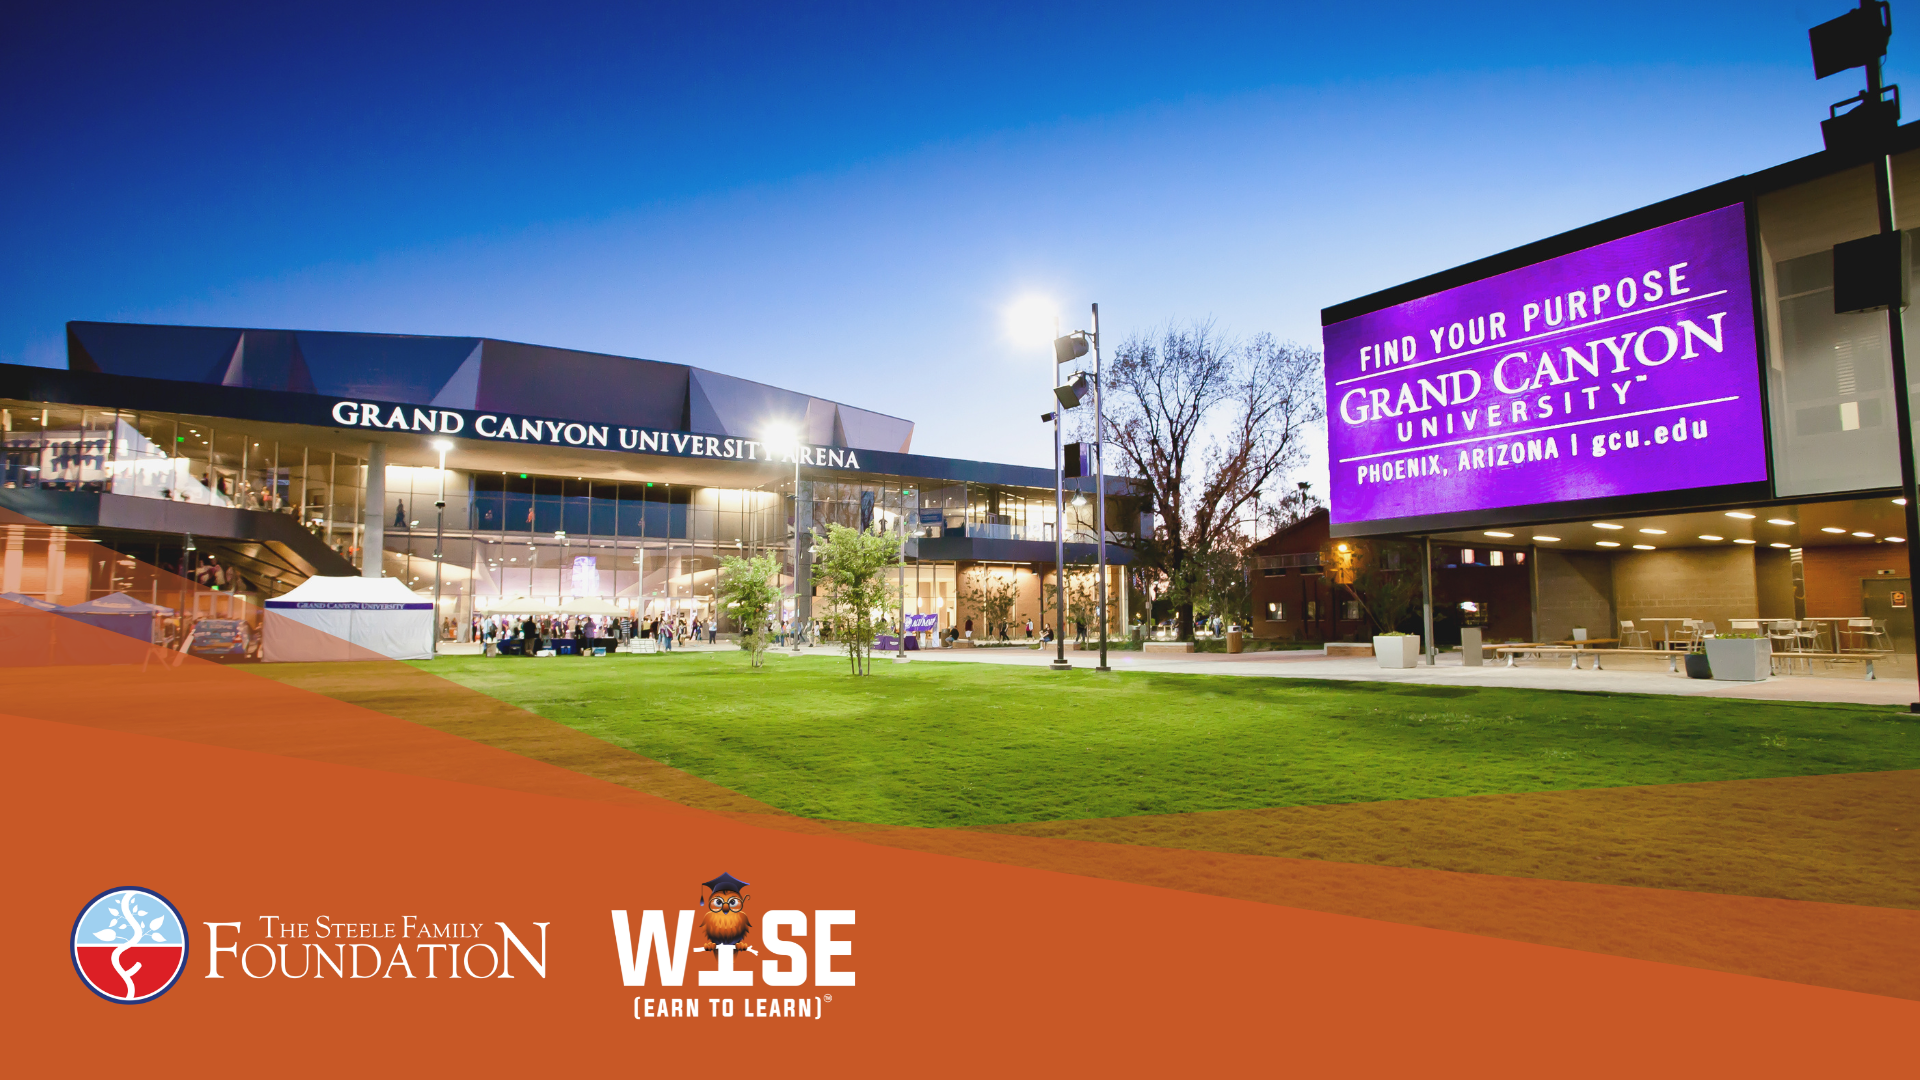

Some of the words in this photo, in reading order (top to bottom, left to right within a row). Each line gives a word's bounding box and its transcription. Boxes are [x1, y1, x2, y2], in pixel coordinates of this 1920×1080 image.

[1360, 335, 1416, 372] FIND
[1430, 311, 1507, 354] YOUR
[1522, 261, 1690, 333] PURPOSE
[1340, 369, 1482, 425] GRAND
[1493, 311, 1727, 395] CANYON
[331, 401, 464, 434] GRAND
[475, 414, 609, 447] CANYON
[1357, 454, 1449, 485] PHOENIX,
[1458, 436, 1559, 472] ARIZONA
[1592, 416, 1708, 458] gcu.edu
